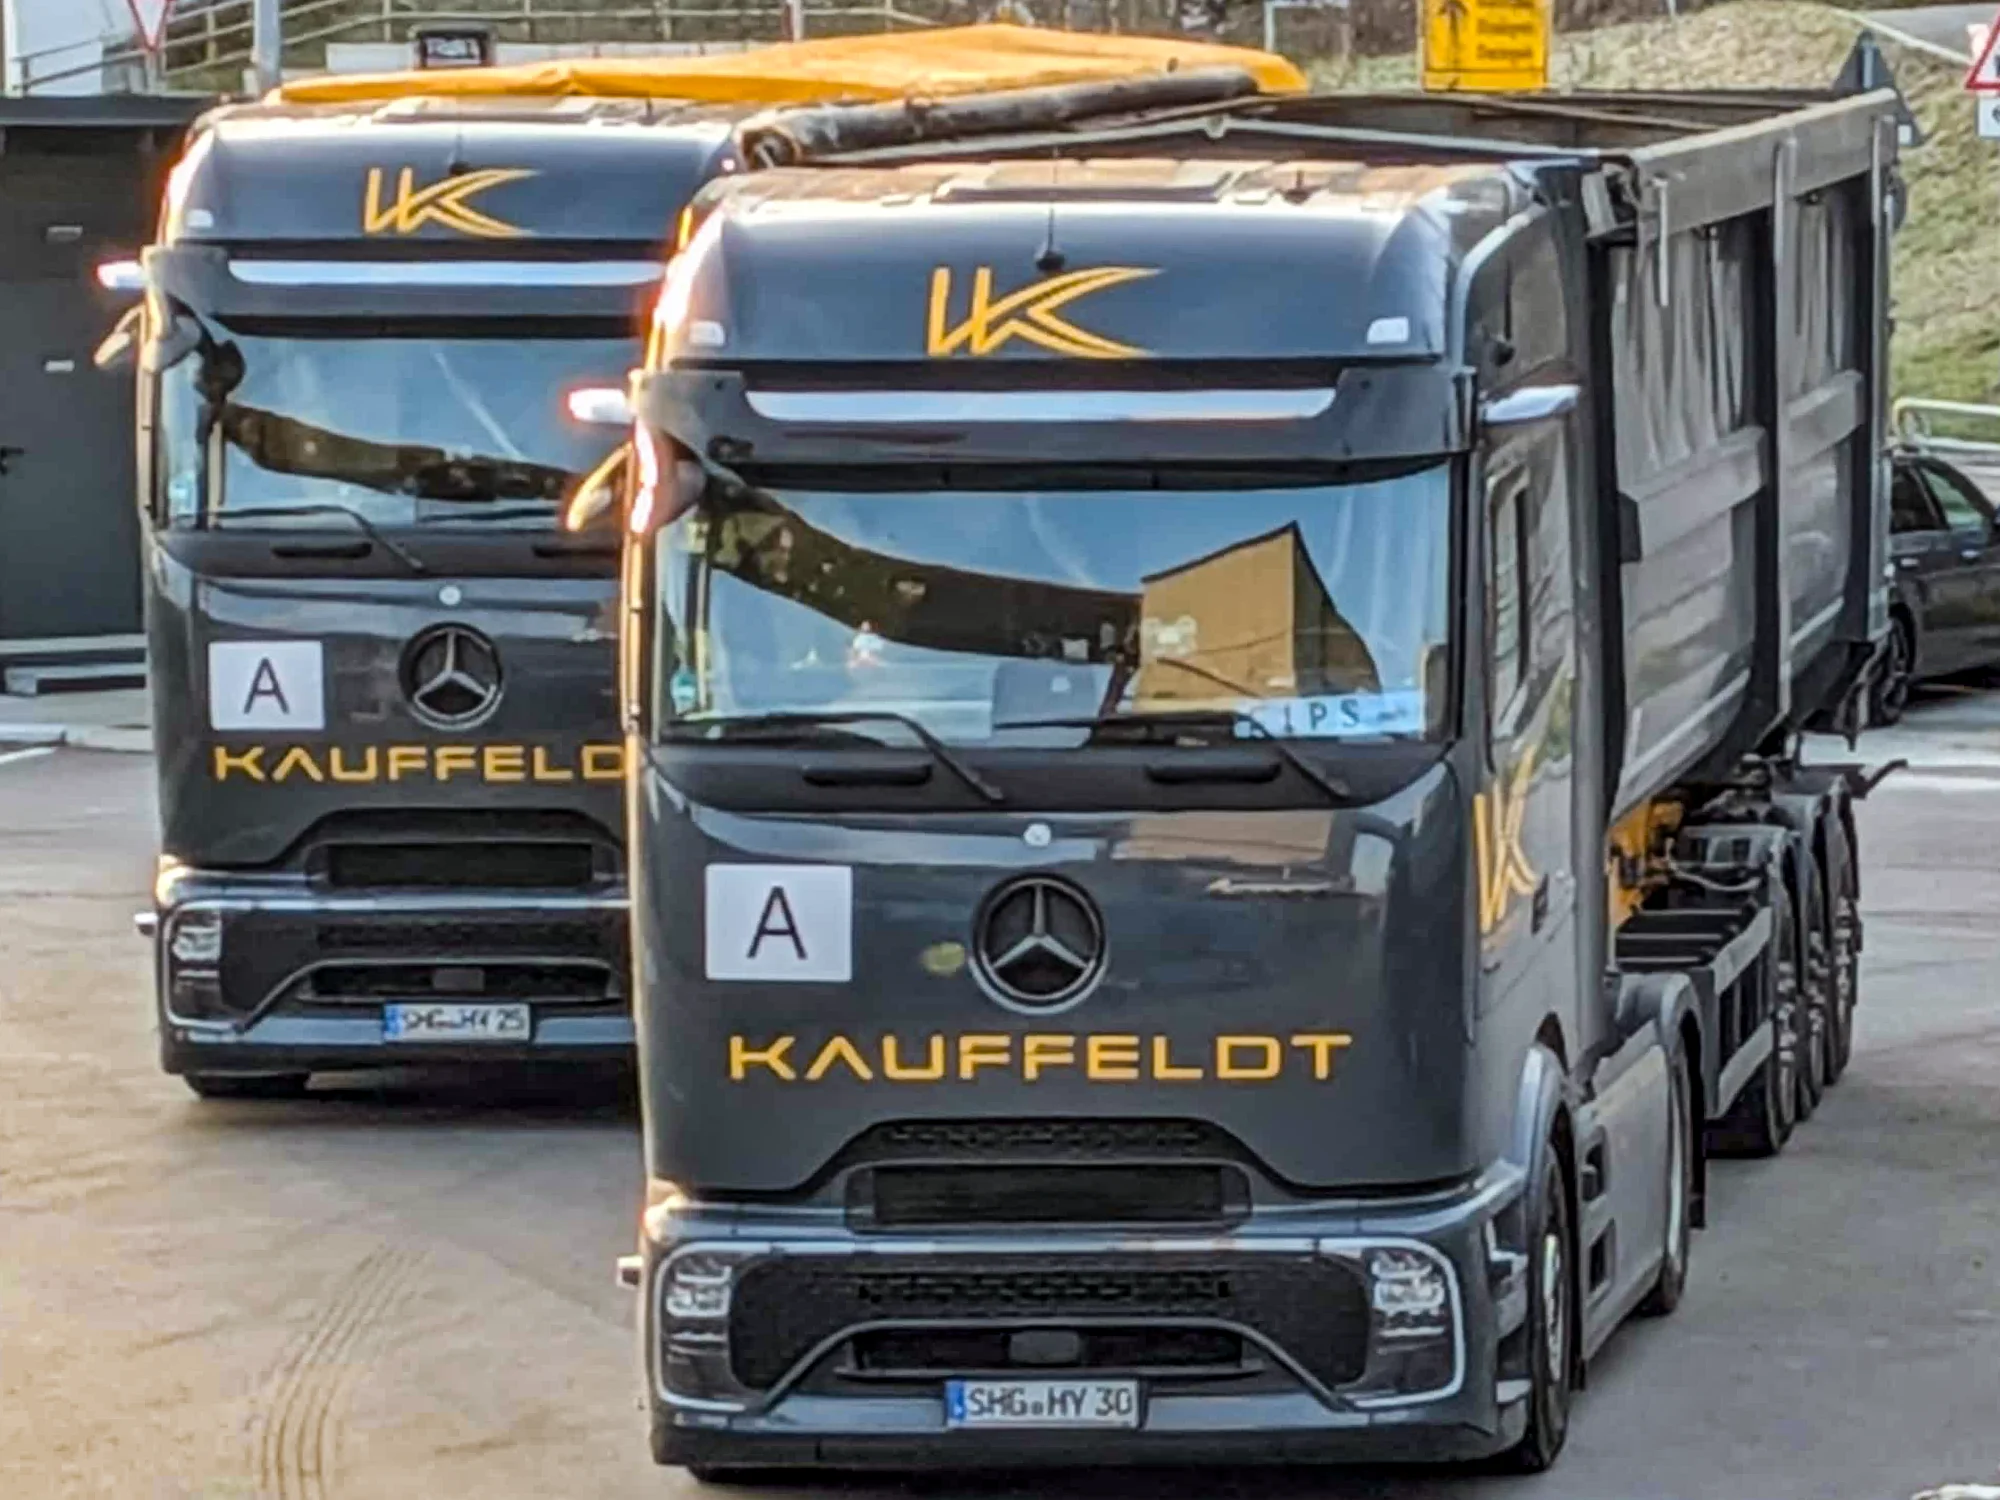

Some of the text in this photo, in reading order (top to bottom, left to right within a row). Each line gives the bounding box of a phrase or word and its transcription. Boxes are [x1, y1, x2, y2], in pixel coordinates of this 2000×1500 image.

[243, 656, 290, 715] A
[213, 744, 628, 783] KAUFFELD
[746, 885, 809, 961] A
[728, 1033, 1353, 1082] KAUFFELDT
[969, 1387, 1132, 1417] SHG HY 30
